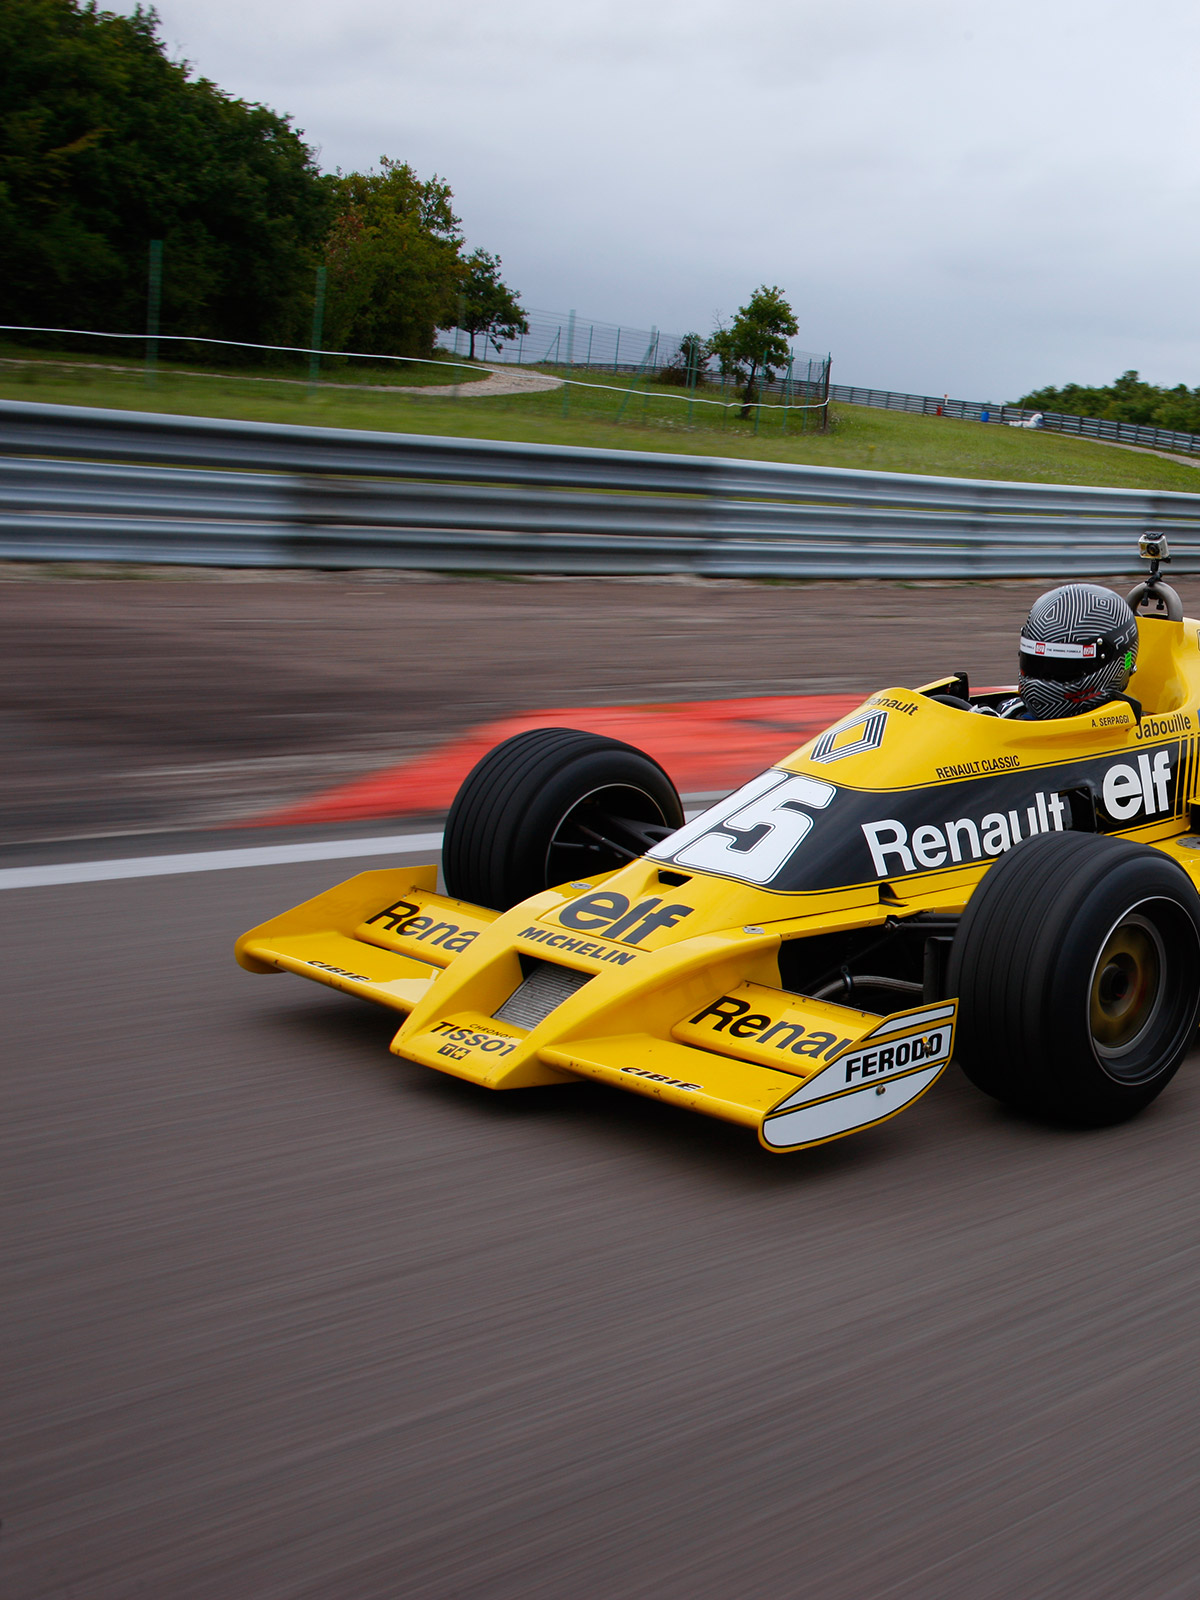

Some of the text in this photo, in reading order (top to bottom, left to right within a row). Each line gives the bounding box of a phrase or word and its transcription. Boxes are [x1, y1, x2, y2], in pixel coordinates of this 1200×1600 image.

[1135, 713, 1191, 739] Jabouille
[936, 755, 1020, 779] RENAULT CLASSIC
[1103, 750, 1171, 820] elf
[645, 771, 836, 885] 15
[861, 792, 1065, 877] Renault
[559, 891, 695, 945] elf
[517, 926, 637, 966] MICHELIN
[621, 1066, 702, 1091] CIBIE
[845, 1033, 942, 1083] FERODO
